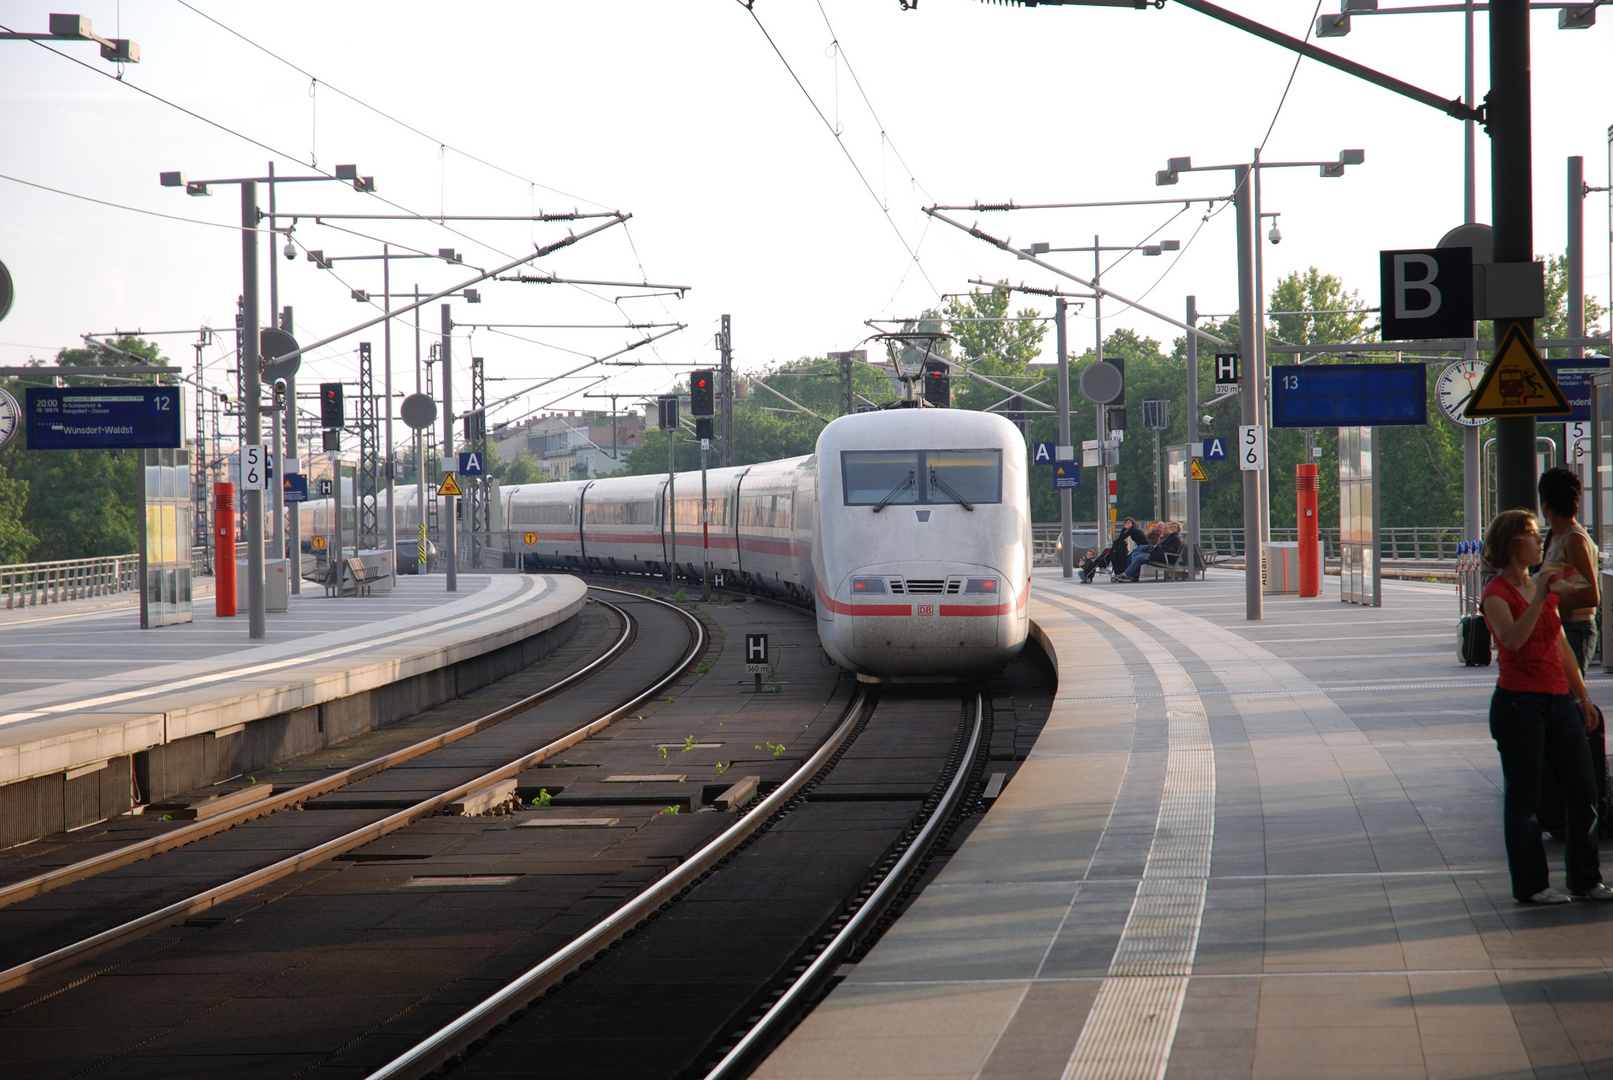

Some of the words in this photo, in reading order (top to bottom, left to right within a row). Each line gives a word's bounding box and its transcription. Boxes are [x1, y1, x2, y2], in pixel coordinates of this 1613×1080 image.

[1393, 253, 1442, 320] B
[1218, 357, 1235, 380] H
[1282, 375, 1299, 390] 13
[36, 399, 58, 408] 20:00
[154, 396, 170, 410] 12
[63, 425, 133, 434] Wünsdorf-Waldst
[1246, 428, 1256, 444] 5
[1573, 422, 1584, 438] 5
[1036, 443, 1050, 460] A
[1210, 438, 1224, 456] A
[248, 448, 258, 464] 5
[466, 452, 480, 470] A
[1246, 448, 1257, 464] 6
[248, 468, 258, 484] 6
[322, 482, 332, 494] H
[714, 574, 724, 586] H
[919, 605, 932, 615] DB
[749, 637, 764, 660] H
